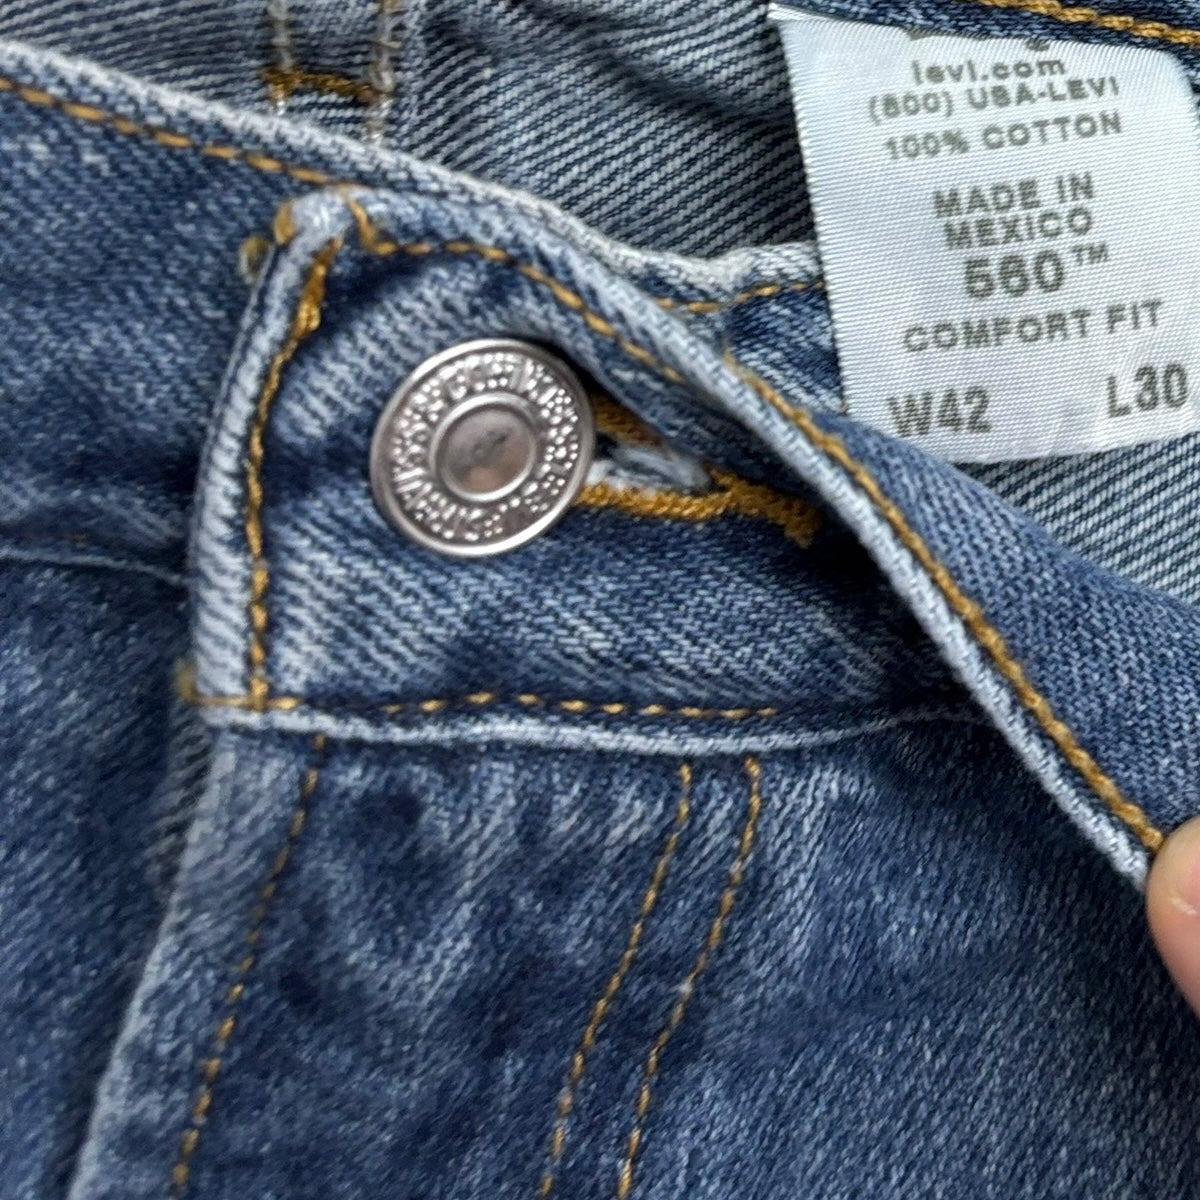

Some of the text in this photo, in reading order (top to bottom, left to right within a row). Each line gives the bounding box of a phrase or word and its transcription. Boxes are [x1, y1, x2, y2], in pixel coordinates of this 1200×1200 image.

[911, 59, 1066, 85] levi.com
[885, 111, 1122, 161] 100% COTTON
[932, 172, 1095, 218] MADE IN
[943, 207, 1093, 250] MEXICO
[903, 300, 1162, 352] COMFORT FIT
[888, 362, 1189, 437] W42 L30
